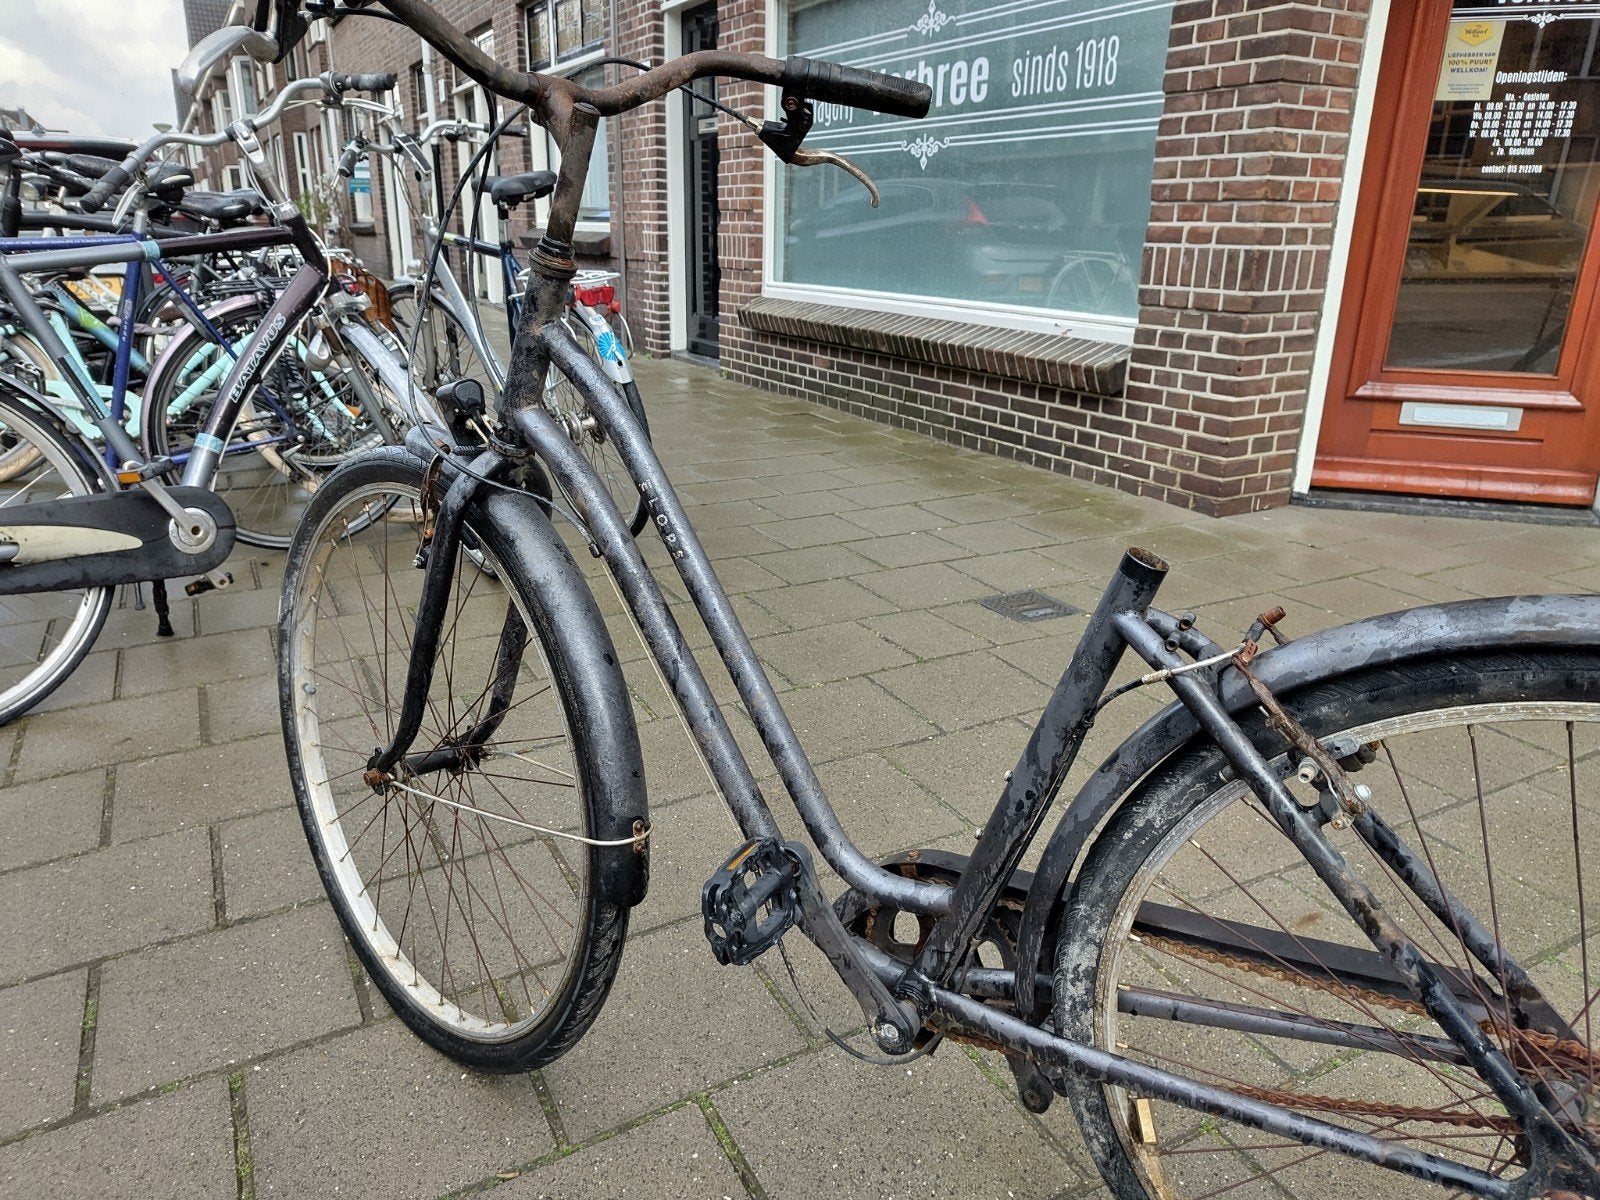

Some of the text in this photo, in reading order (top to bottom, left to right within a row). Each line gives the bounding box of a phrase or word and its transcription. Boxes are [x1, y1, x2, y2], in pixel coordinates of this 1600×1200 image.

[1011, 46, 1068, 98] sinds
[1075, 35, 1121, 89] 1918
[1495, 70, 1568, 85] Openingstijden:
[229, 313, 286, 403] BATAVUS
